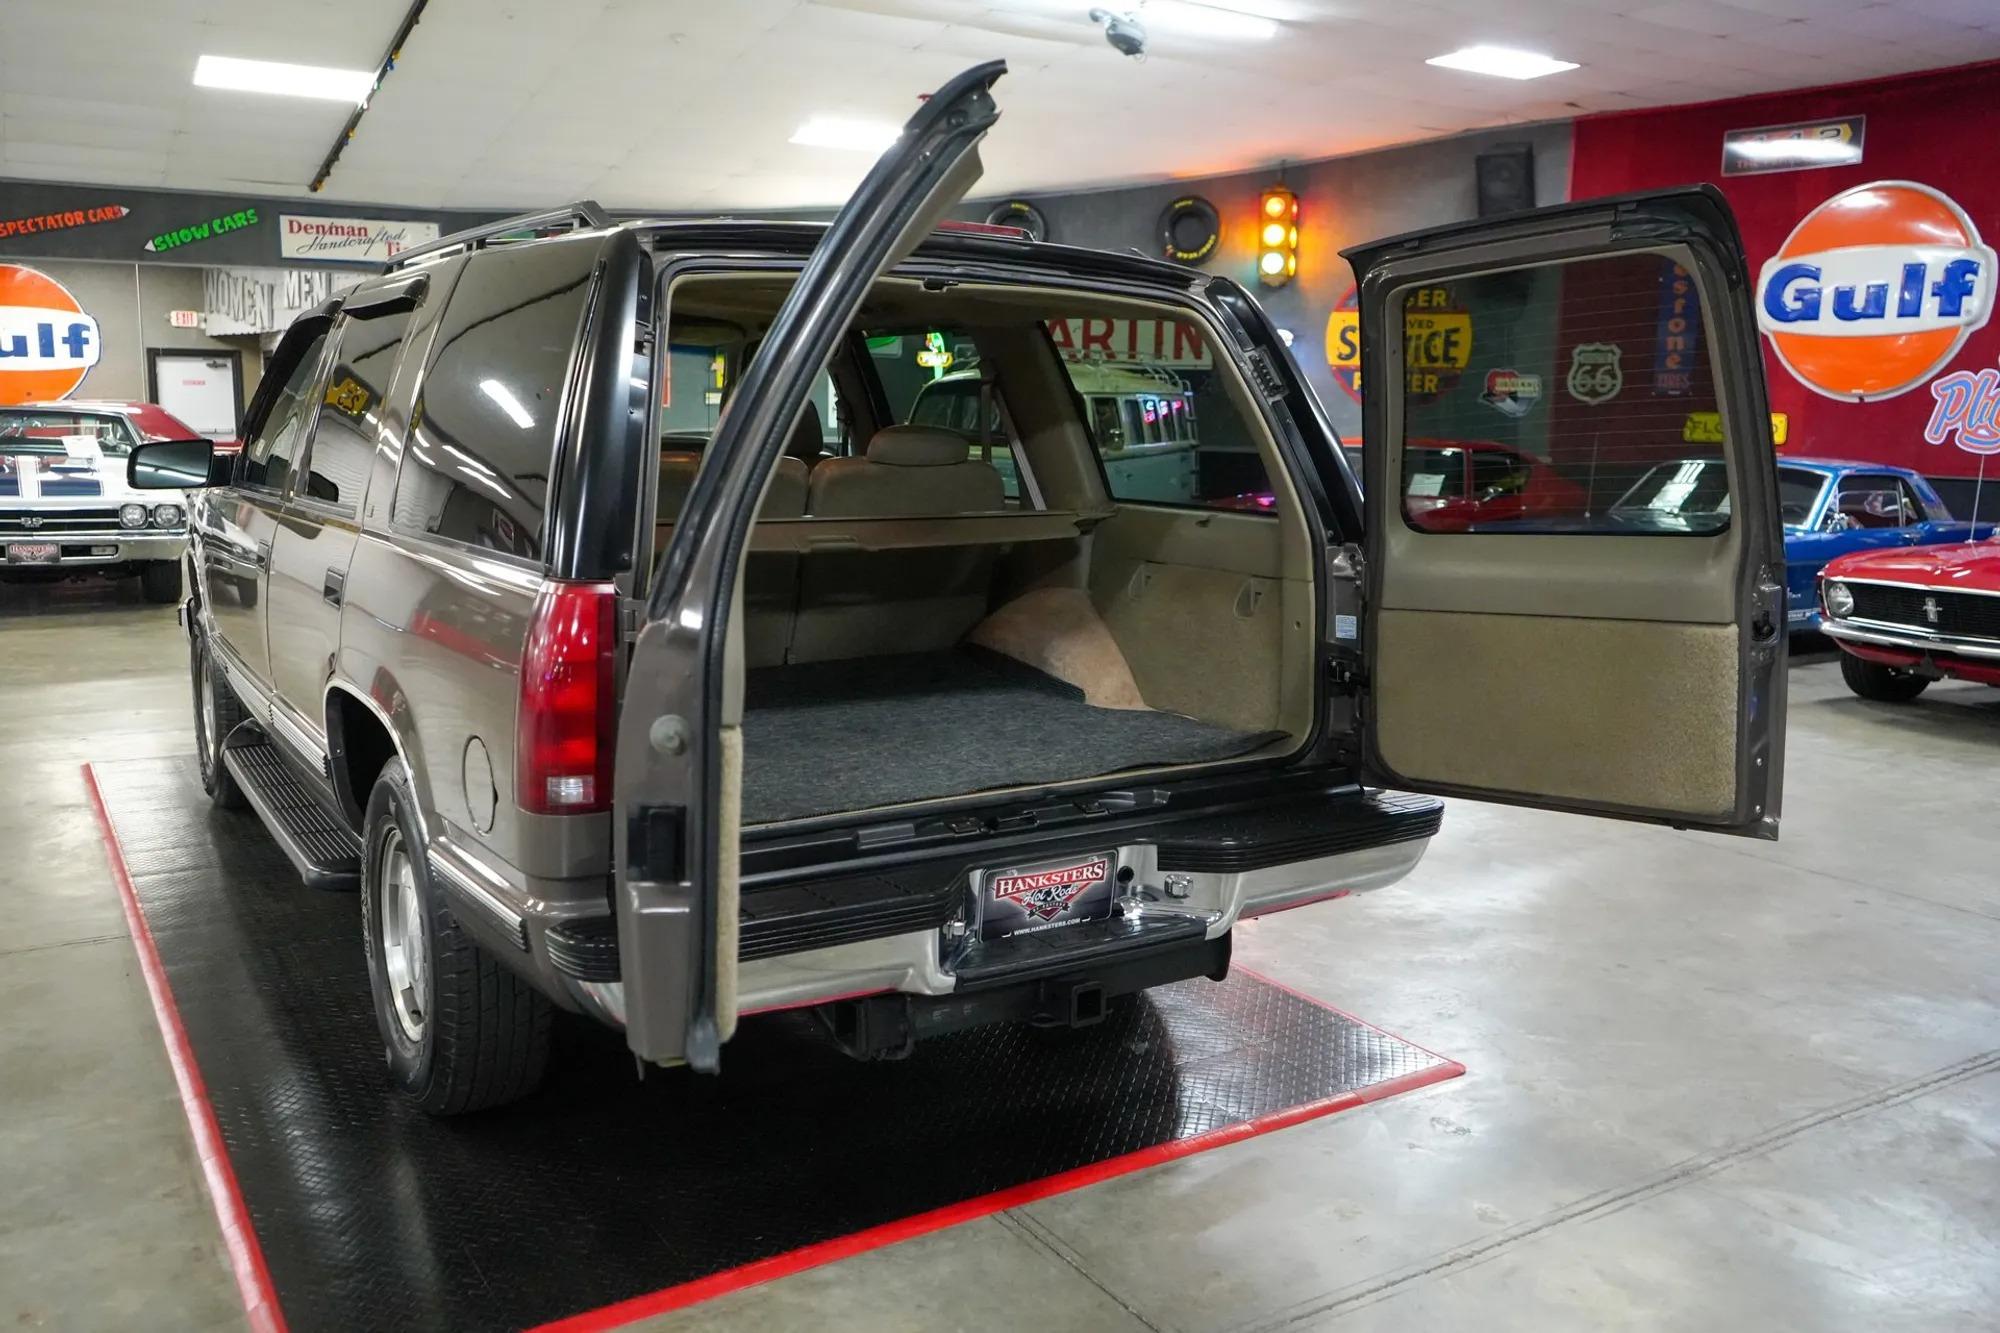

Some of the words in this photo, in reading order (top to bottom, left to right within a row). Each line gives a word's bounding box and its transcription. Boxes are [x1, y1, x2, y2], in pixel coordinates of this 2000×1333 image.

[0, 210, 85, 237] SPECTATOR
[88, 205, 122, 222] CARS
[154, 223, 210, 251] SHOW
[212, 208, 258, 234] CARS
[288, 219, 368, 237] Denman
[296, 223, 405, 256] Handcrafted
[204, 268, 275, 329] WOMEN
[1763, 259, 1981, 322] Gulf
[176, 312, 193, 327] EXIT
[1665, 265, 1689, 369] estone
[0, 323, 90, 358] ulf
[1045, 318, 1205, 361] ARTIN
[1576, 365, 1614, 393] 66
[999, 863, 1103, 896] HANKSTERS
[1021, 888, 1046, 905] Hot
[1047, 883, 1078, 902] Rods
[1014, 918, 1081, 936] WWW.HANKSTERS.COM
